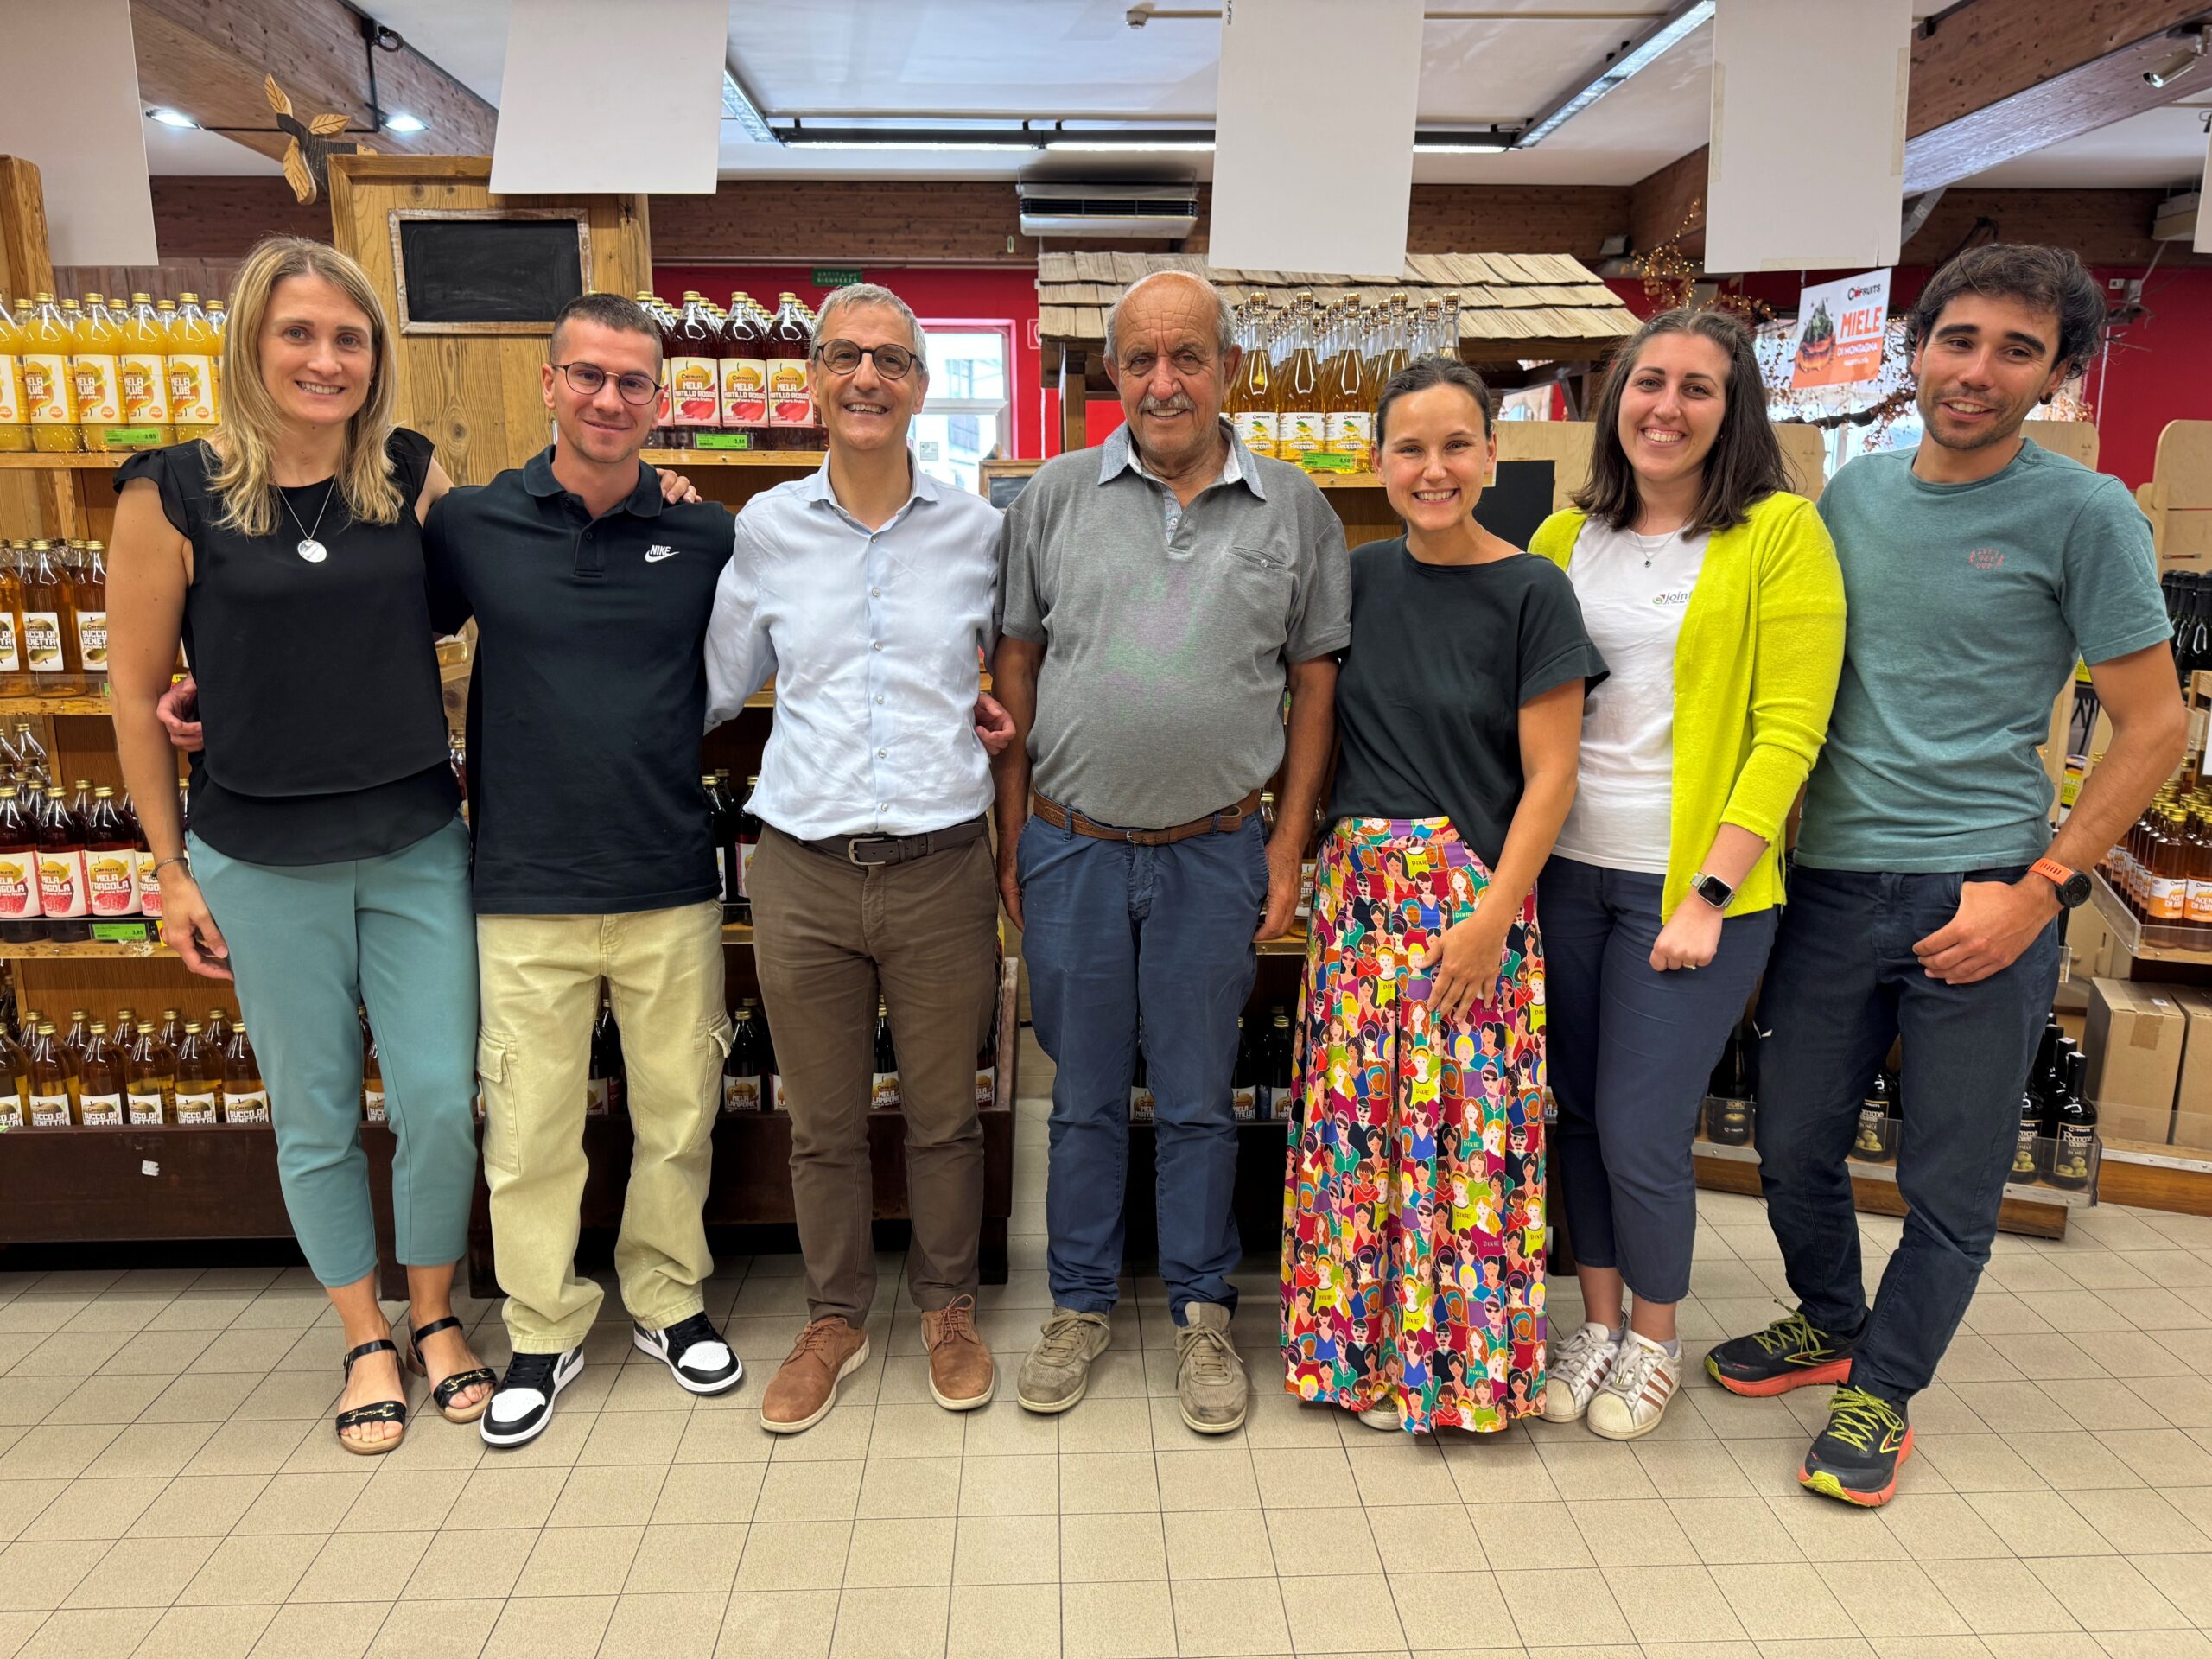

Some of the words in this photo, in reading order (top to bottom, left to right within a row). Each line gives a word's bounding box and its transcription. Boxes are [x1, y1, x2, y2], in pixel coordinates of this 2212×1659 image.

[1840, 306, 1883, 339] MIELE
[683, 381, 703, 390] MELA
[733, 383, 753, 391] MELA
[650, 544, 671, 556] NIKE
[96, 874, 118, 882] MELA
[1463, 1140, 1480, 1148] DIXIE
